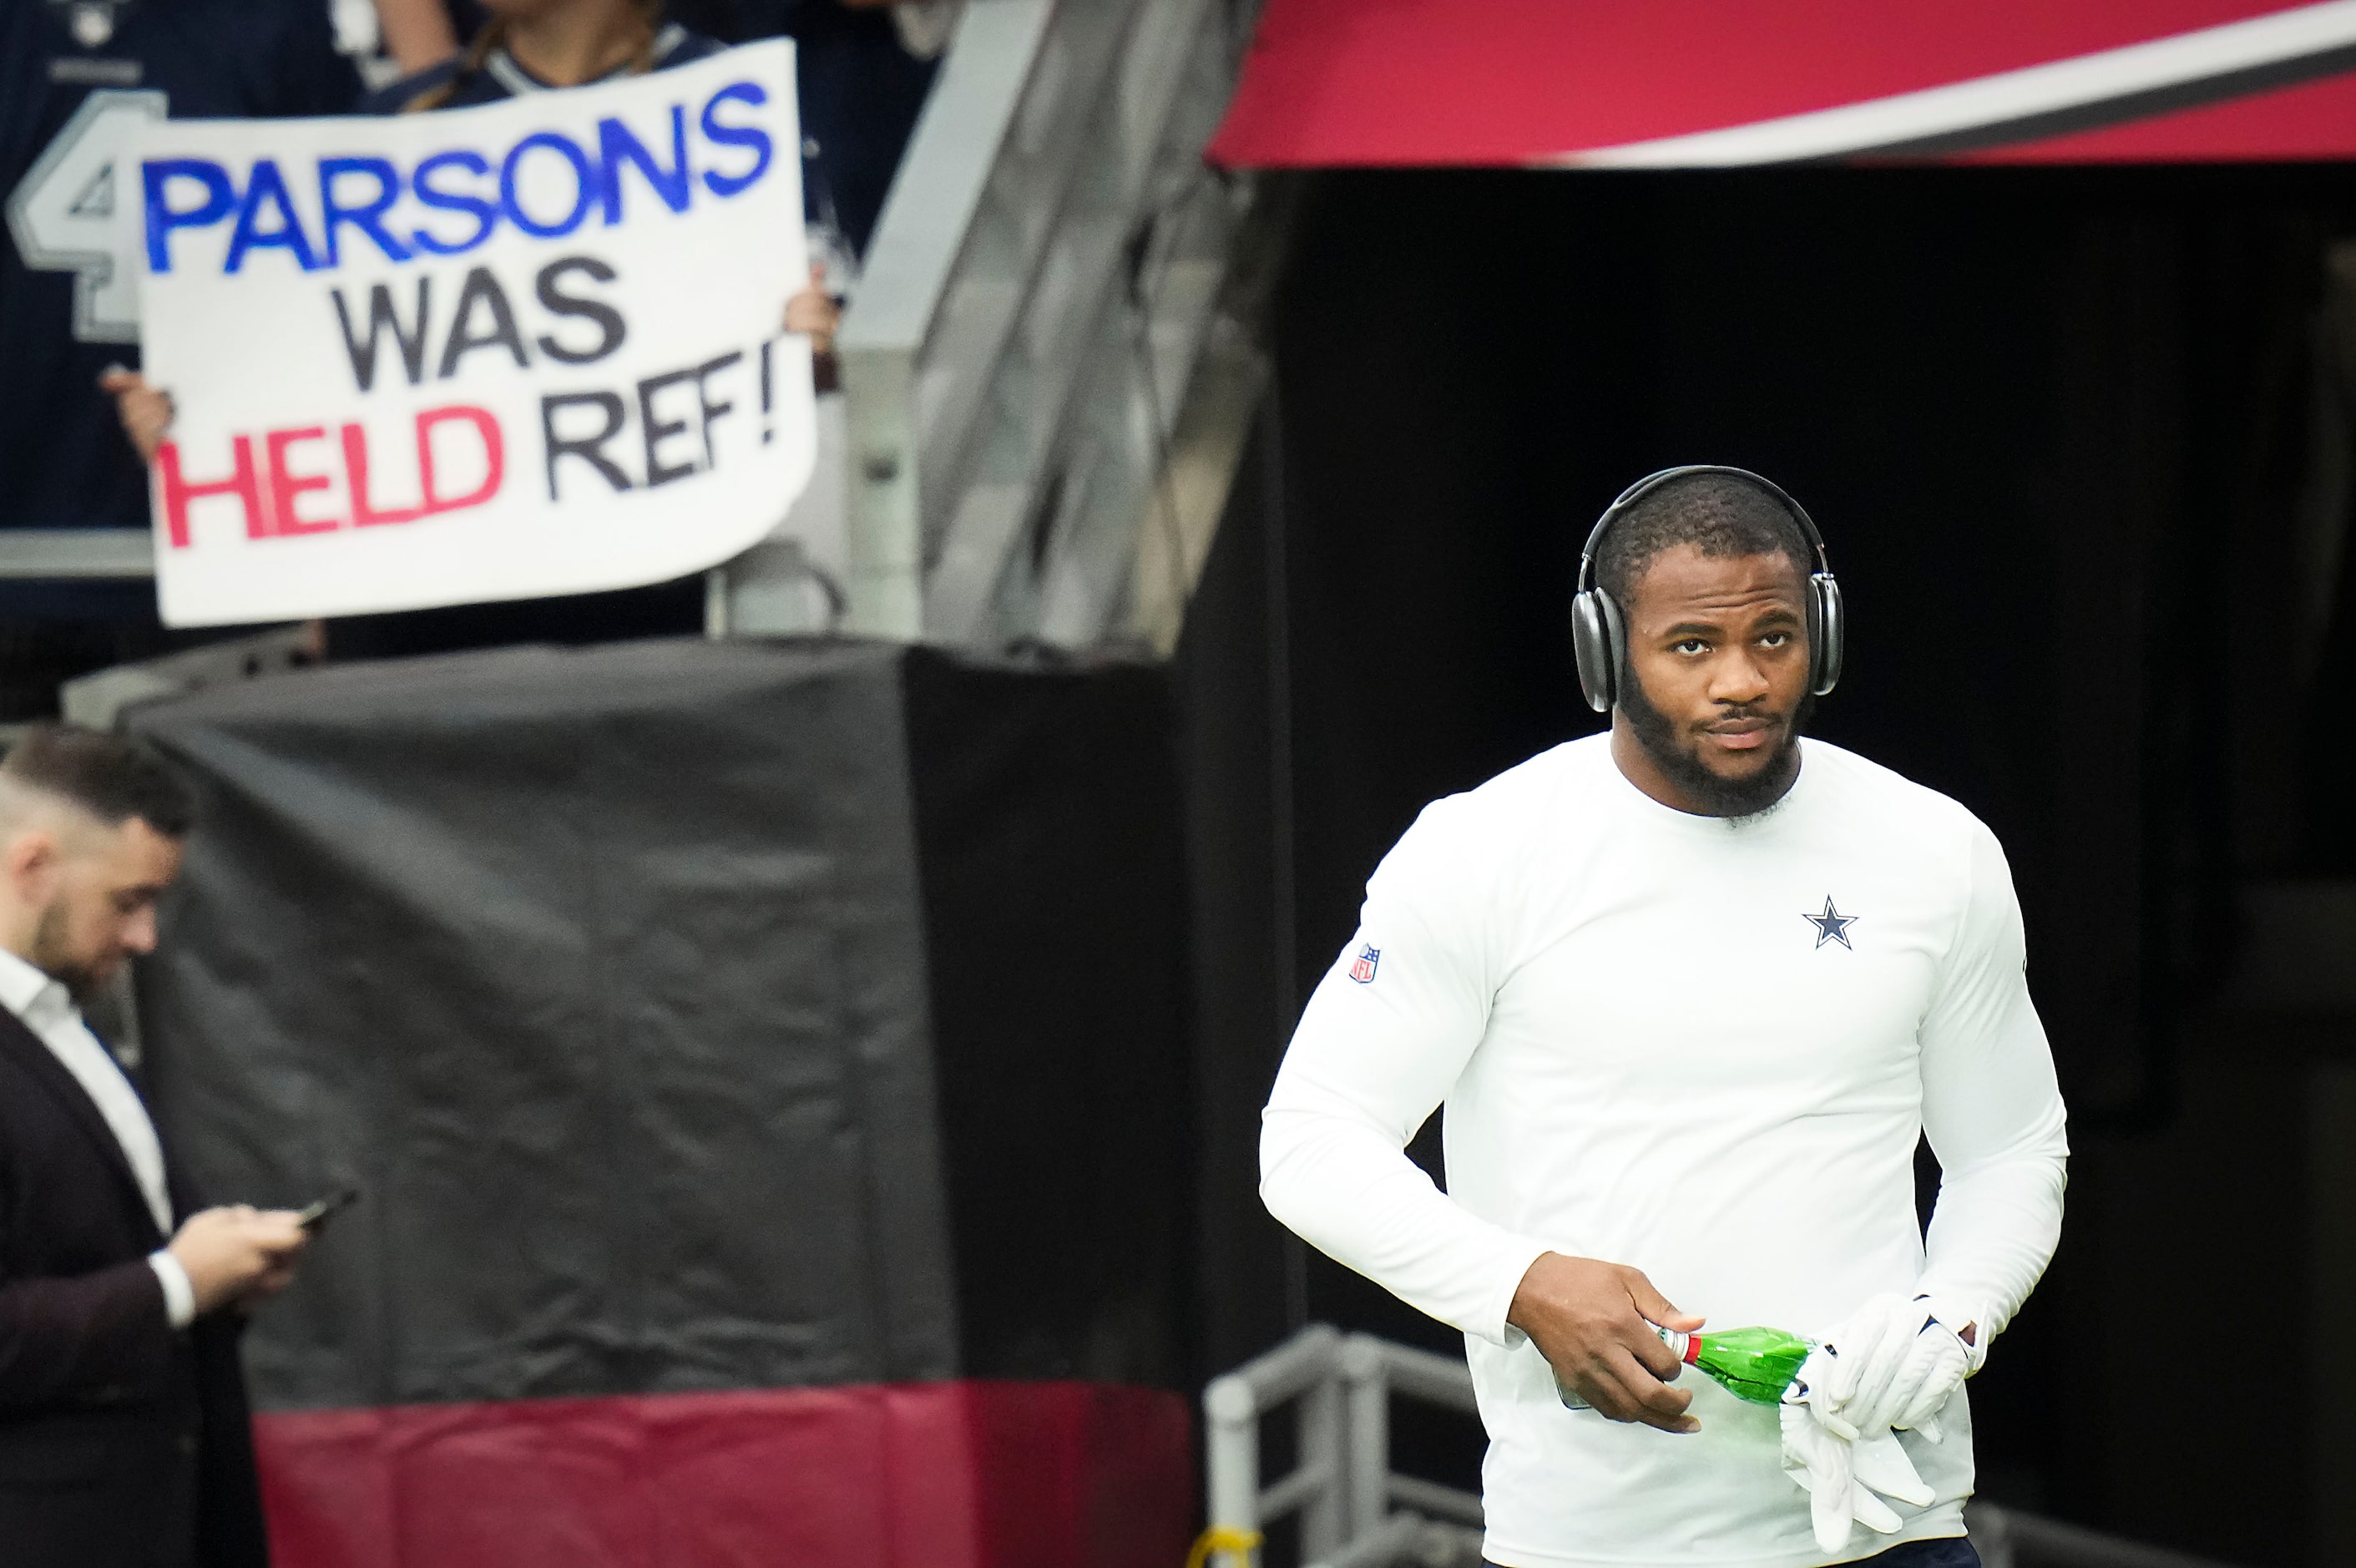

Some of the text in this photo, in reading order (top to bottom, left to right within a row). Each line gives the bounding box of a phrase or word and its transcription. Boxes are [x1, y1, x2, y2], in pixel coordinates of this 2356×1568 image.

[4, 89, 169, 343] 4
[140, 81, 774, 276] PARSONS
[331, 255, 628, 392] WAS
[155, 340, 773, 549] HELD REF!
[1351, 959, 1372, 980] NFL
